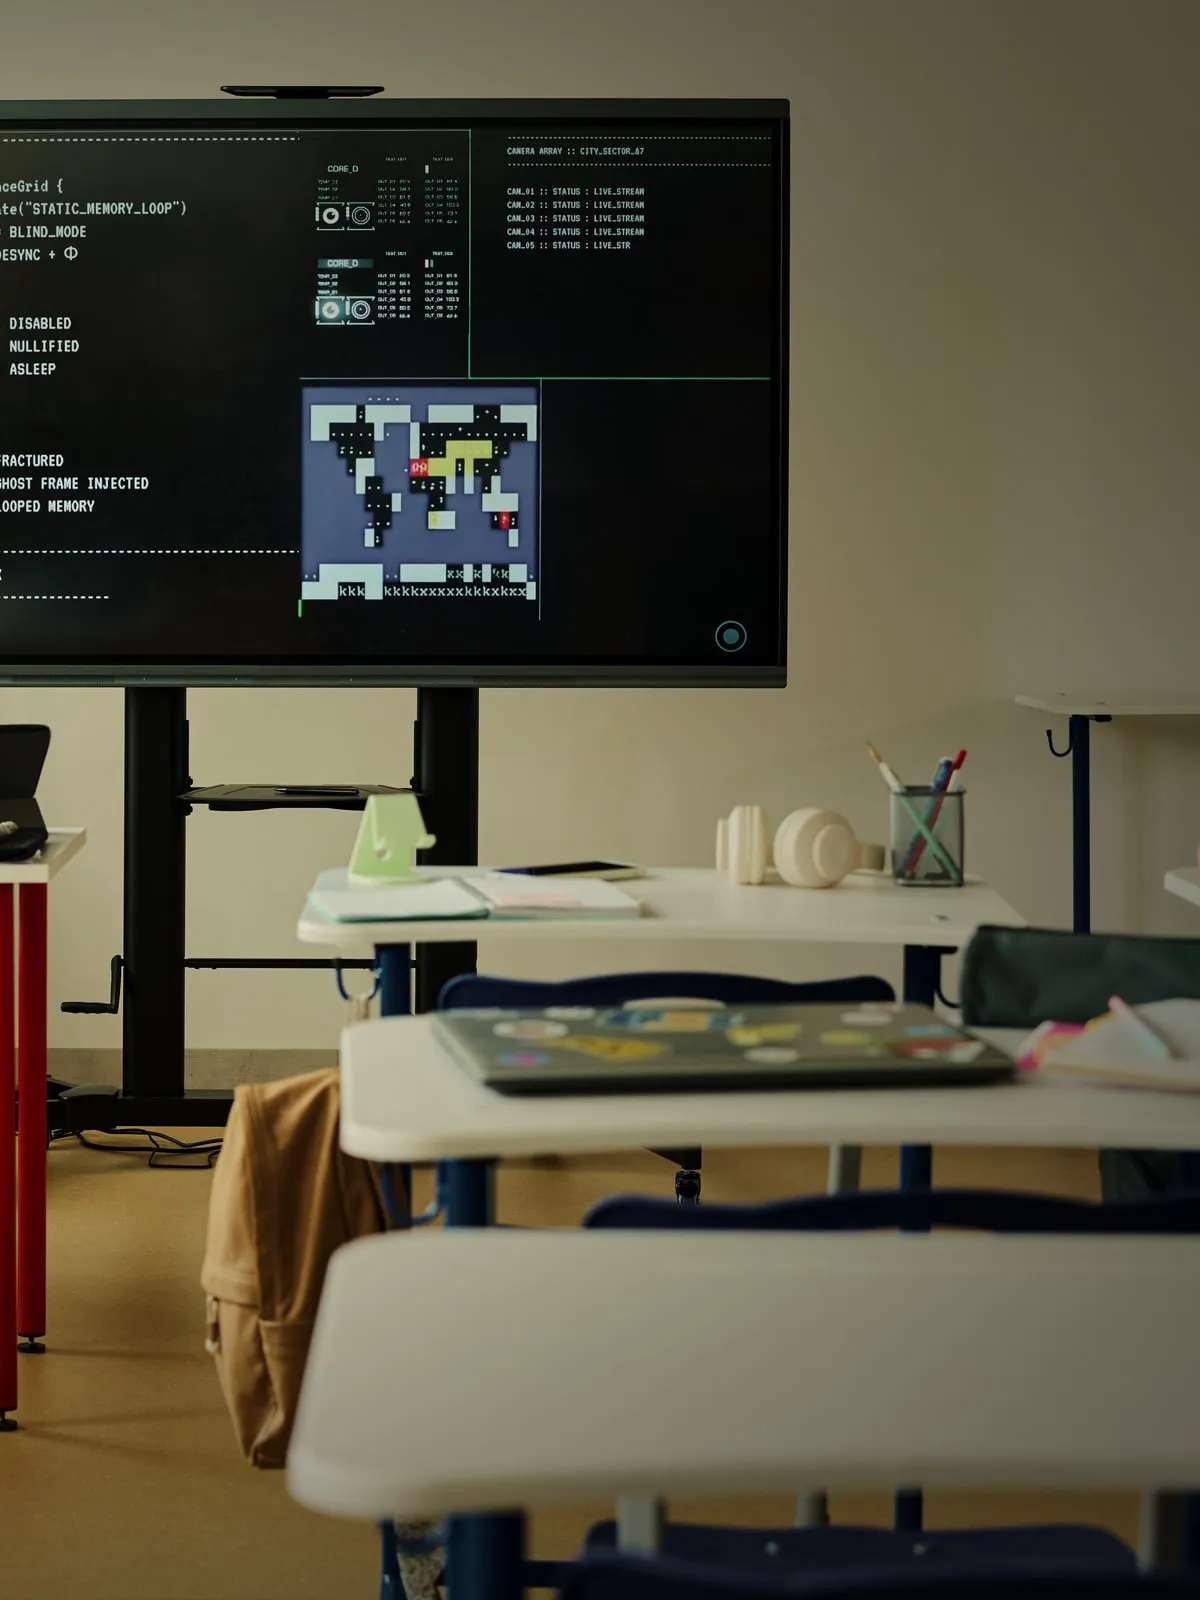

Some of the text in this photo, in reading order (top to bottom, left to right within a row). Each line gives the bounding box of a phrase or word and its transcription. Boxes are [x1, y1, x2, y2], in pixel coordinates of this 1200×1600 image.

[540, 147, 563, 156] ARRAY
[327, 164, 359, 174] CORE_D
[553, 187, 580, 196] STATUS
[553, 200, 580, 209] STATUS
[553, 214, 580, 223] STATUS
[10, 226, 86, 238] BLIND_MODE
[553, 227, 580, 236] STATUS
[553, 241, 580, 250] STATUS
[594, 241, 630, 250] LIVE_STR
[327, 259, 359, 269] CORE_D
[10, 317, 71, 330] DISABLED
[10, 340, 79, 352] NULLIFIED
[10, 363, 56, 375] ASLEEP
[41, 477, 78, 489] FRAME
[88, 477, 148, 489] INJECTED
[48, 500, 94, 512] MEMORY
